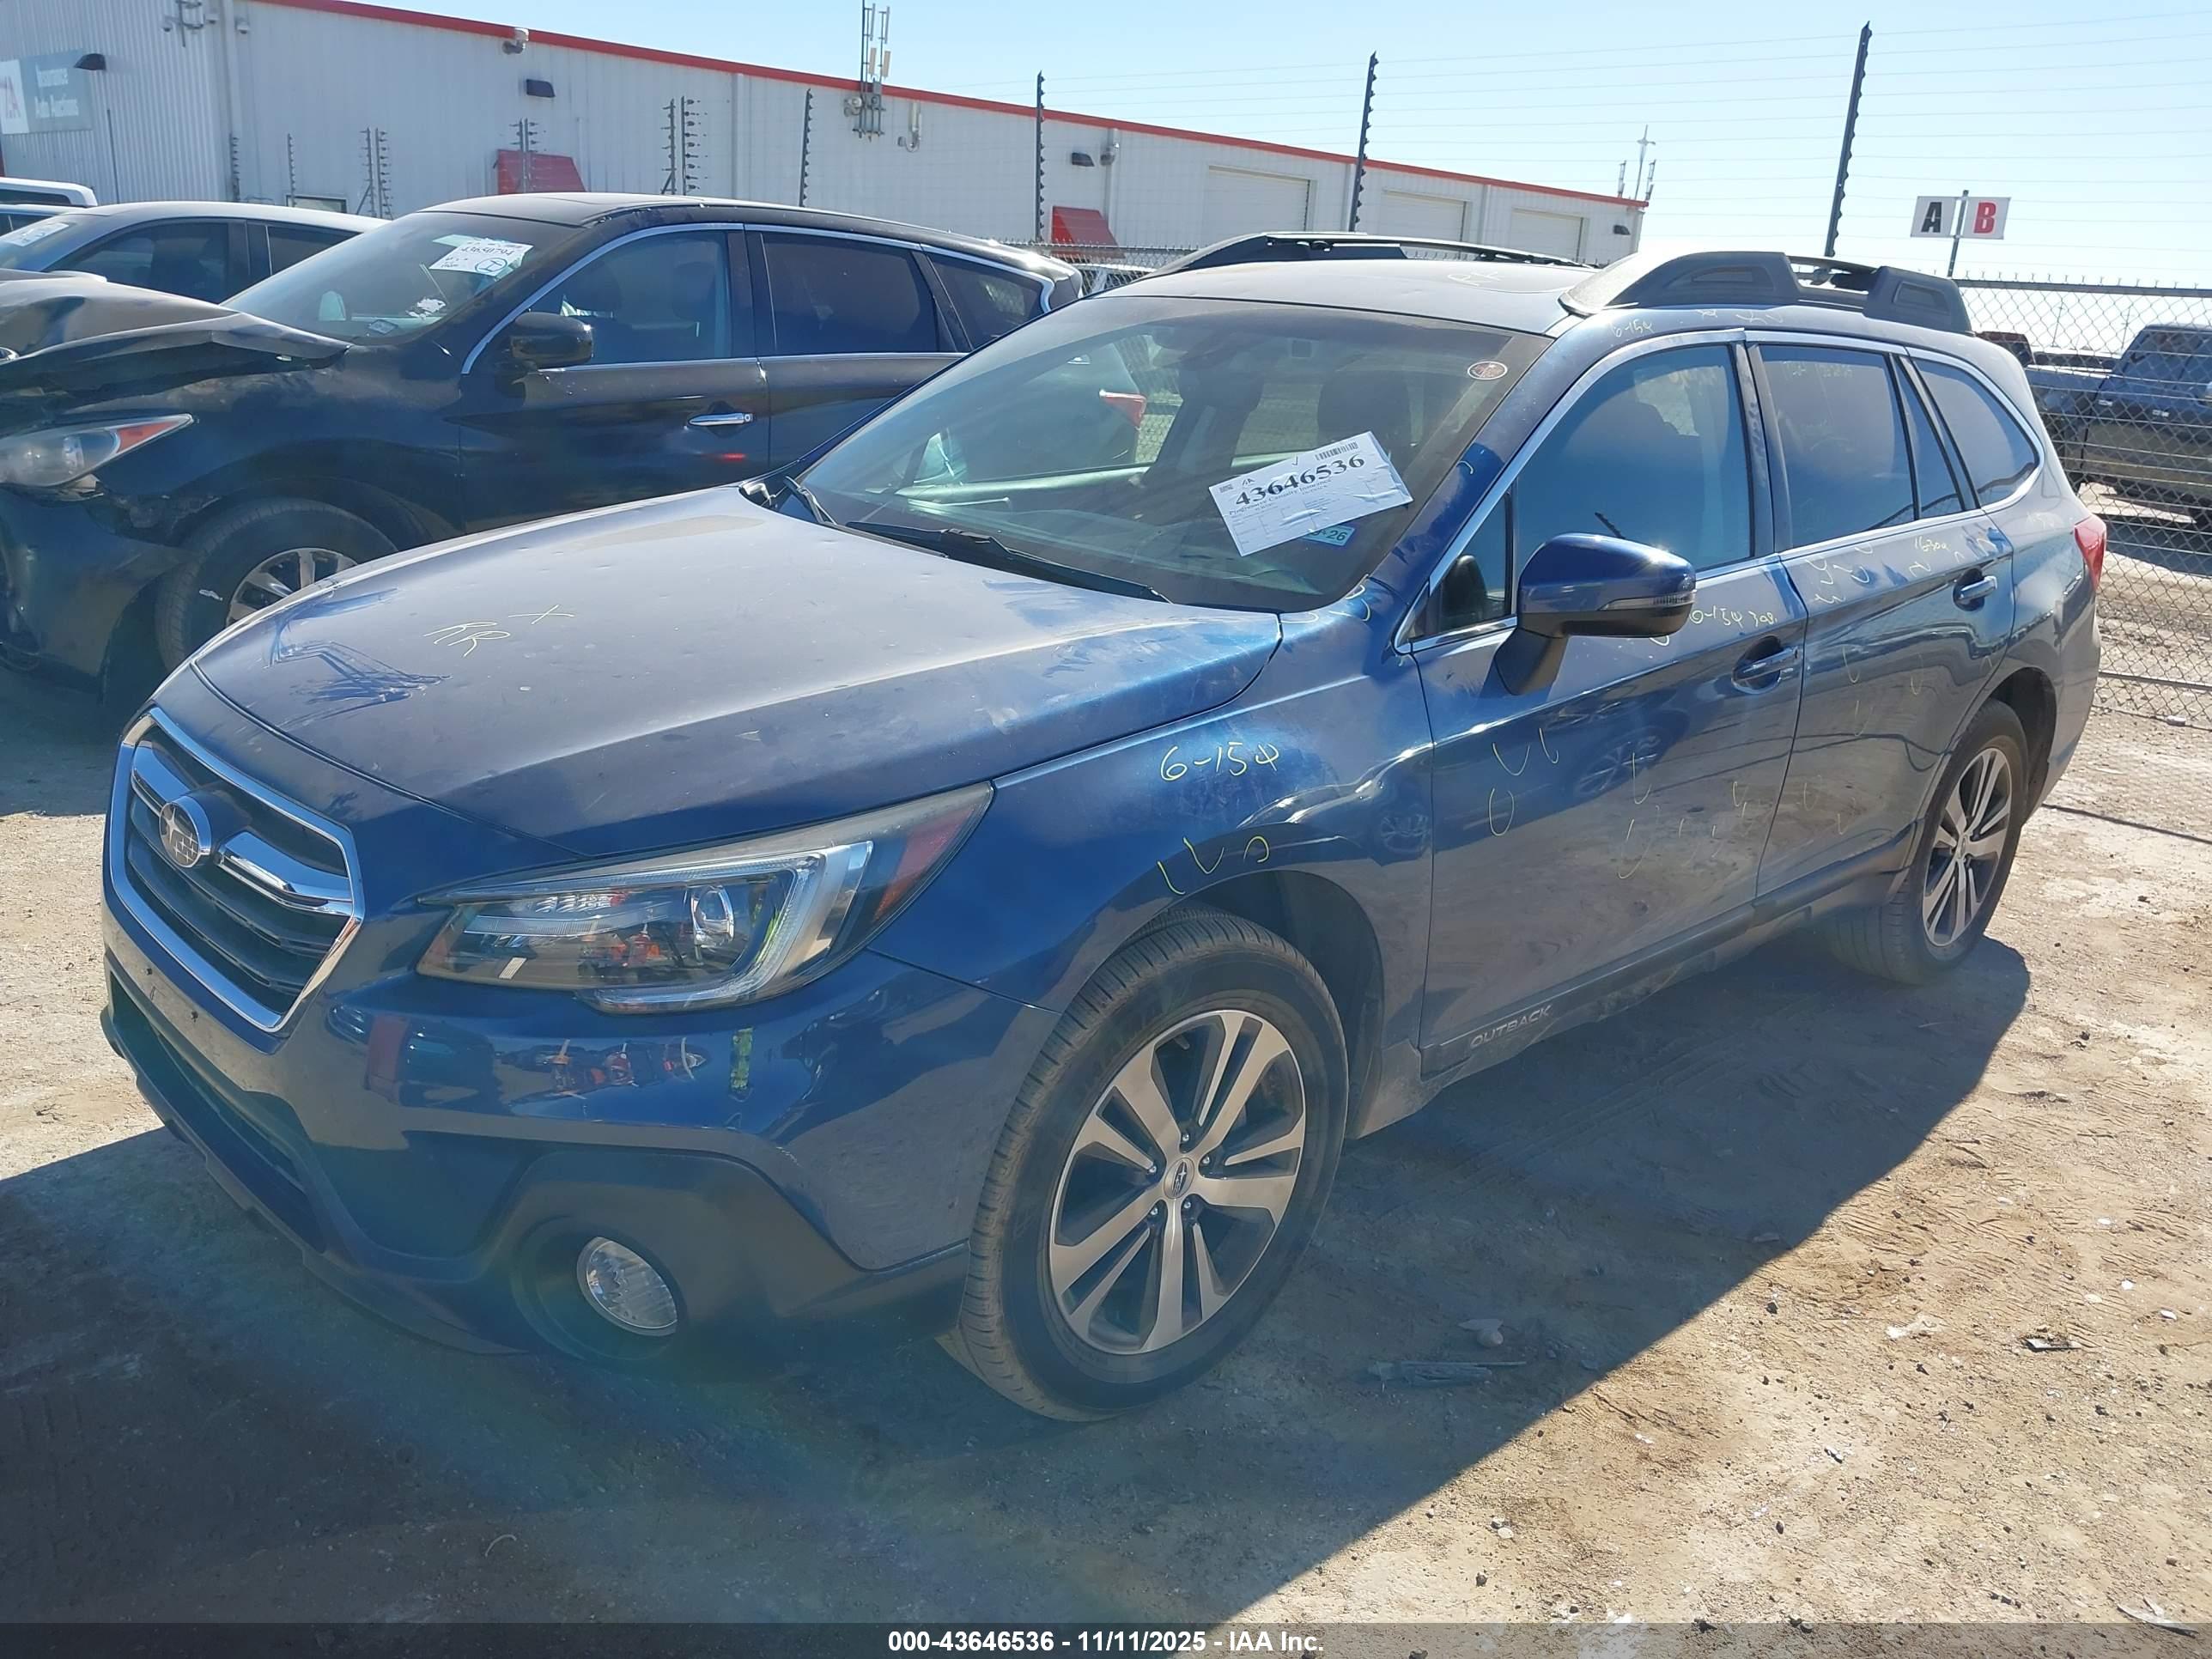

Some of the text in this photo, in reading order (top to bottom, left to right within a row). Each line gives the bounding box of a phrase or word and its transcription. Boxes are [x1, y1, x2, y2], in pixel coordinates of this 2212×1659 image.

[1921, 202, 1942, 233] A
[1973, 202, 1996, 234] B
[1237, 453, 1364, 505] 43646536
[1326, 530, 1348, 541] 26
[1470, 1004, 1553, 1048] OUTBACK
